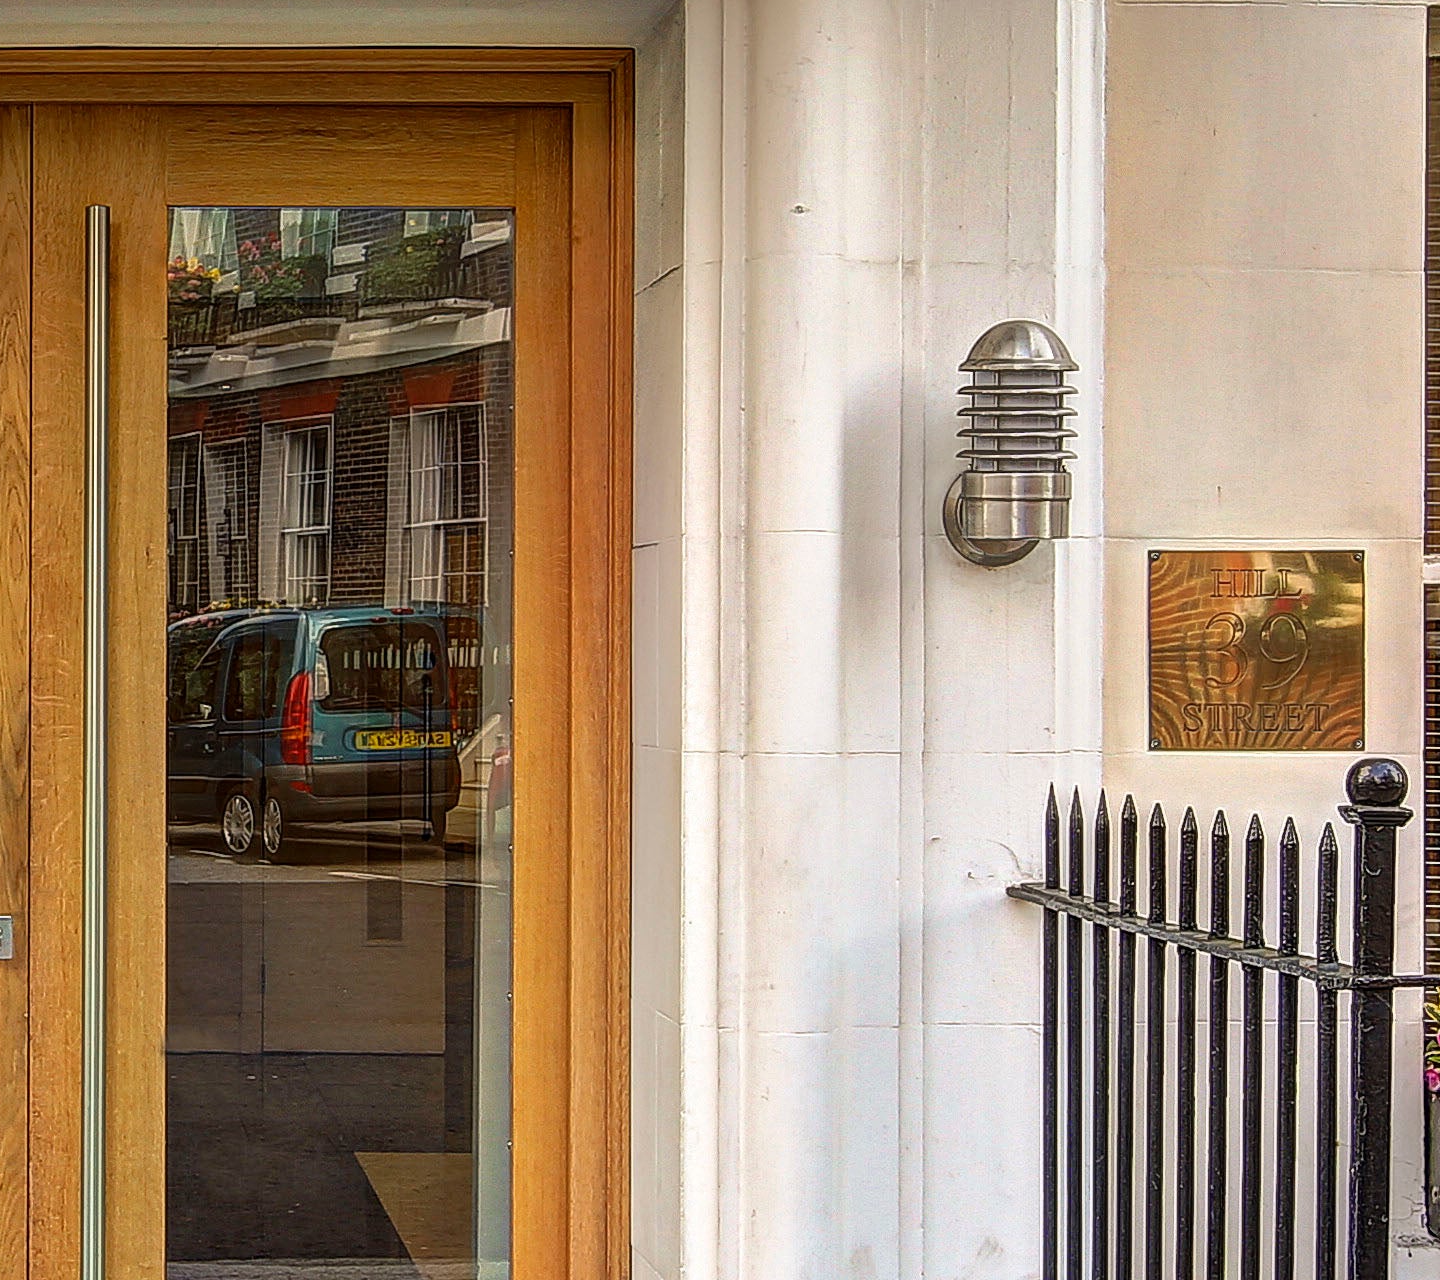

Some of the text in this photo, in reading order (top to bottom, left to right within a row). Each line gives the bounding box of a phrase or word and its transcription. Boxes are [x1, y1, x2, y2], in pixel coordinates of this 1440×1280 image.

[1209, 568, 1302, 599] HILL
[1204, 611, 1311, 691] 39
[1181, 702, 1330, 733] STREET
